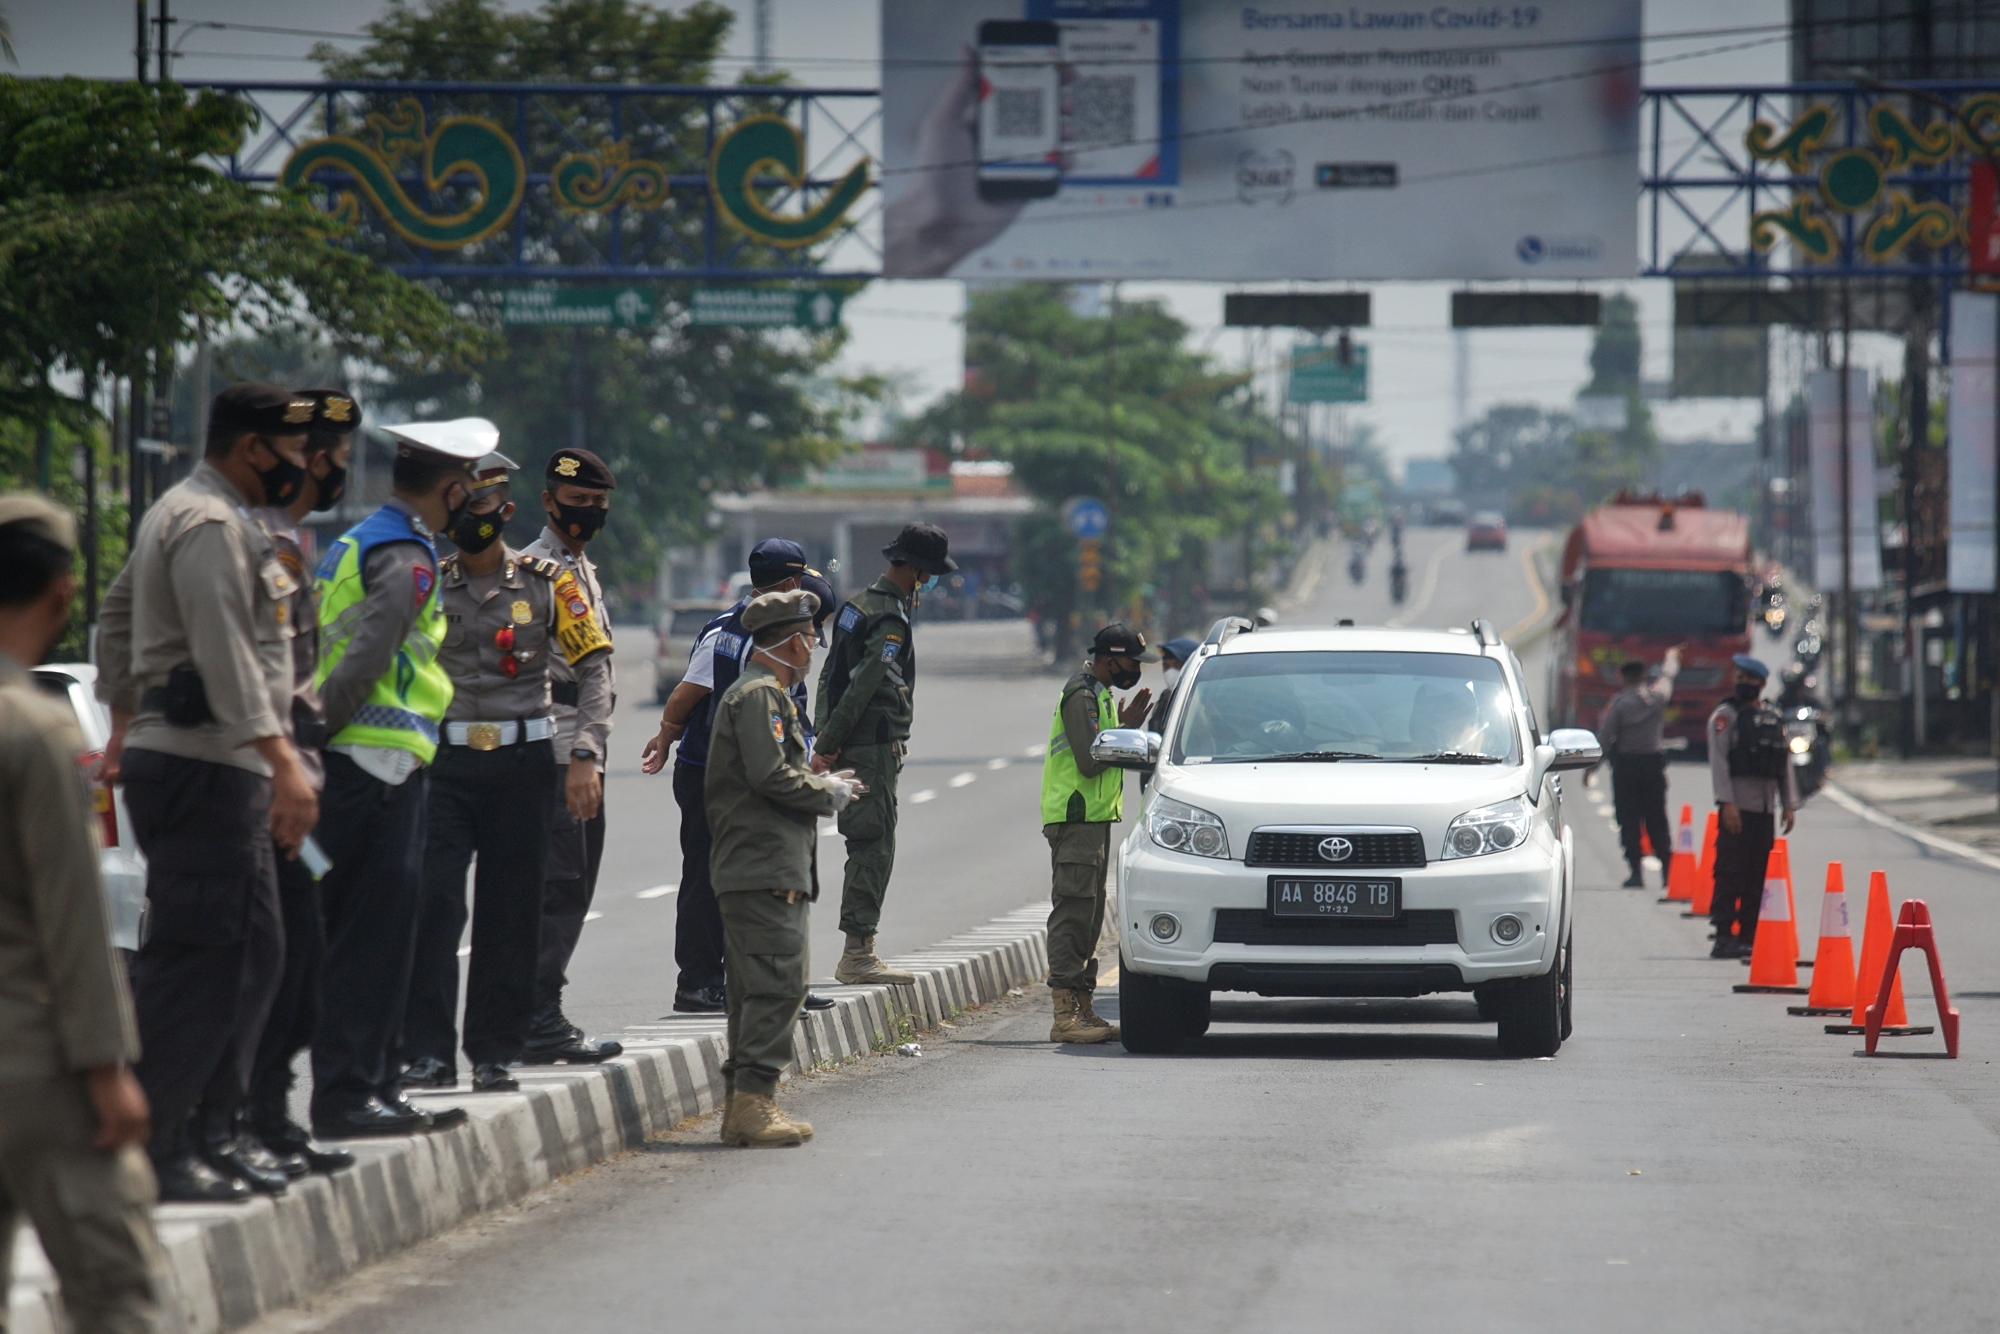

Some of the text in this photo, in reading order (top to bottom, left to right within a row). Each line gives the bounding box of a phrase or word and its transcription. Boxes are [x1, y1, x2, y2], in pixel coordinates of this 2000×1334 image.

[1242, 6, 1541, 30] Bersama Lawan Covid-19
[1242, 75, 1284, 93] Non
[1289, 75, 1339, 93] Tunai
[1345, 75, 1418, 97] dengan
[1281, 882, 1389, 905] AA 8846 TB
